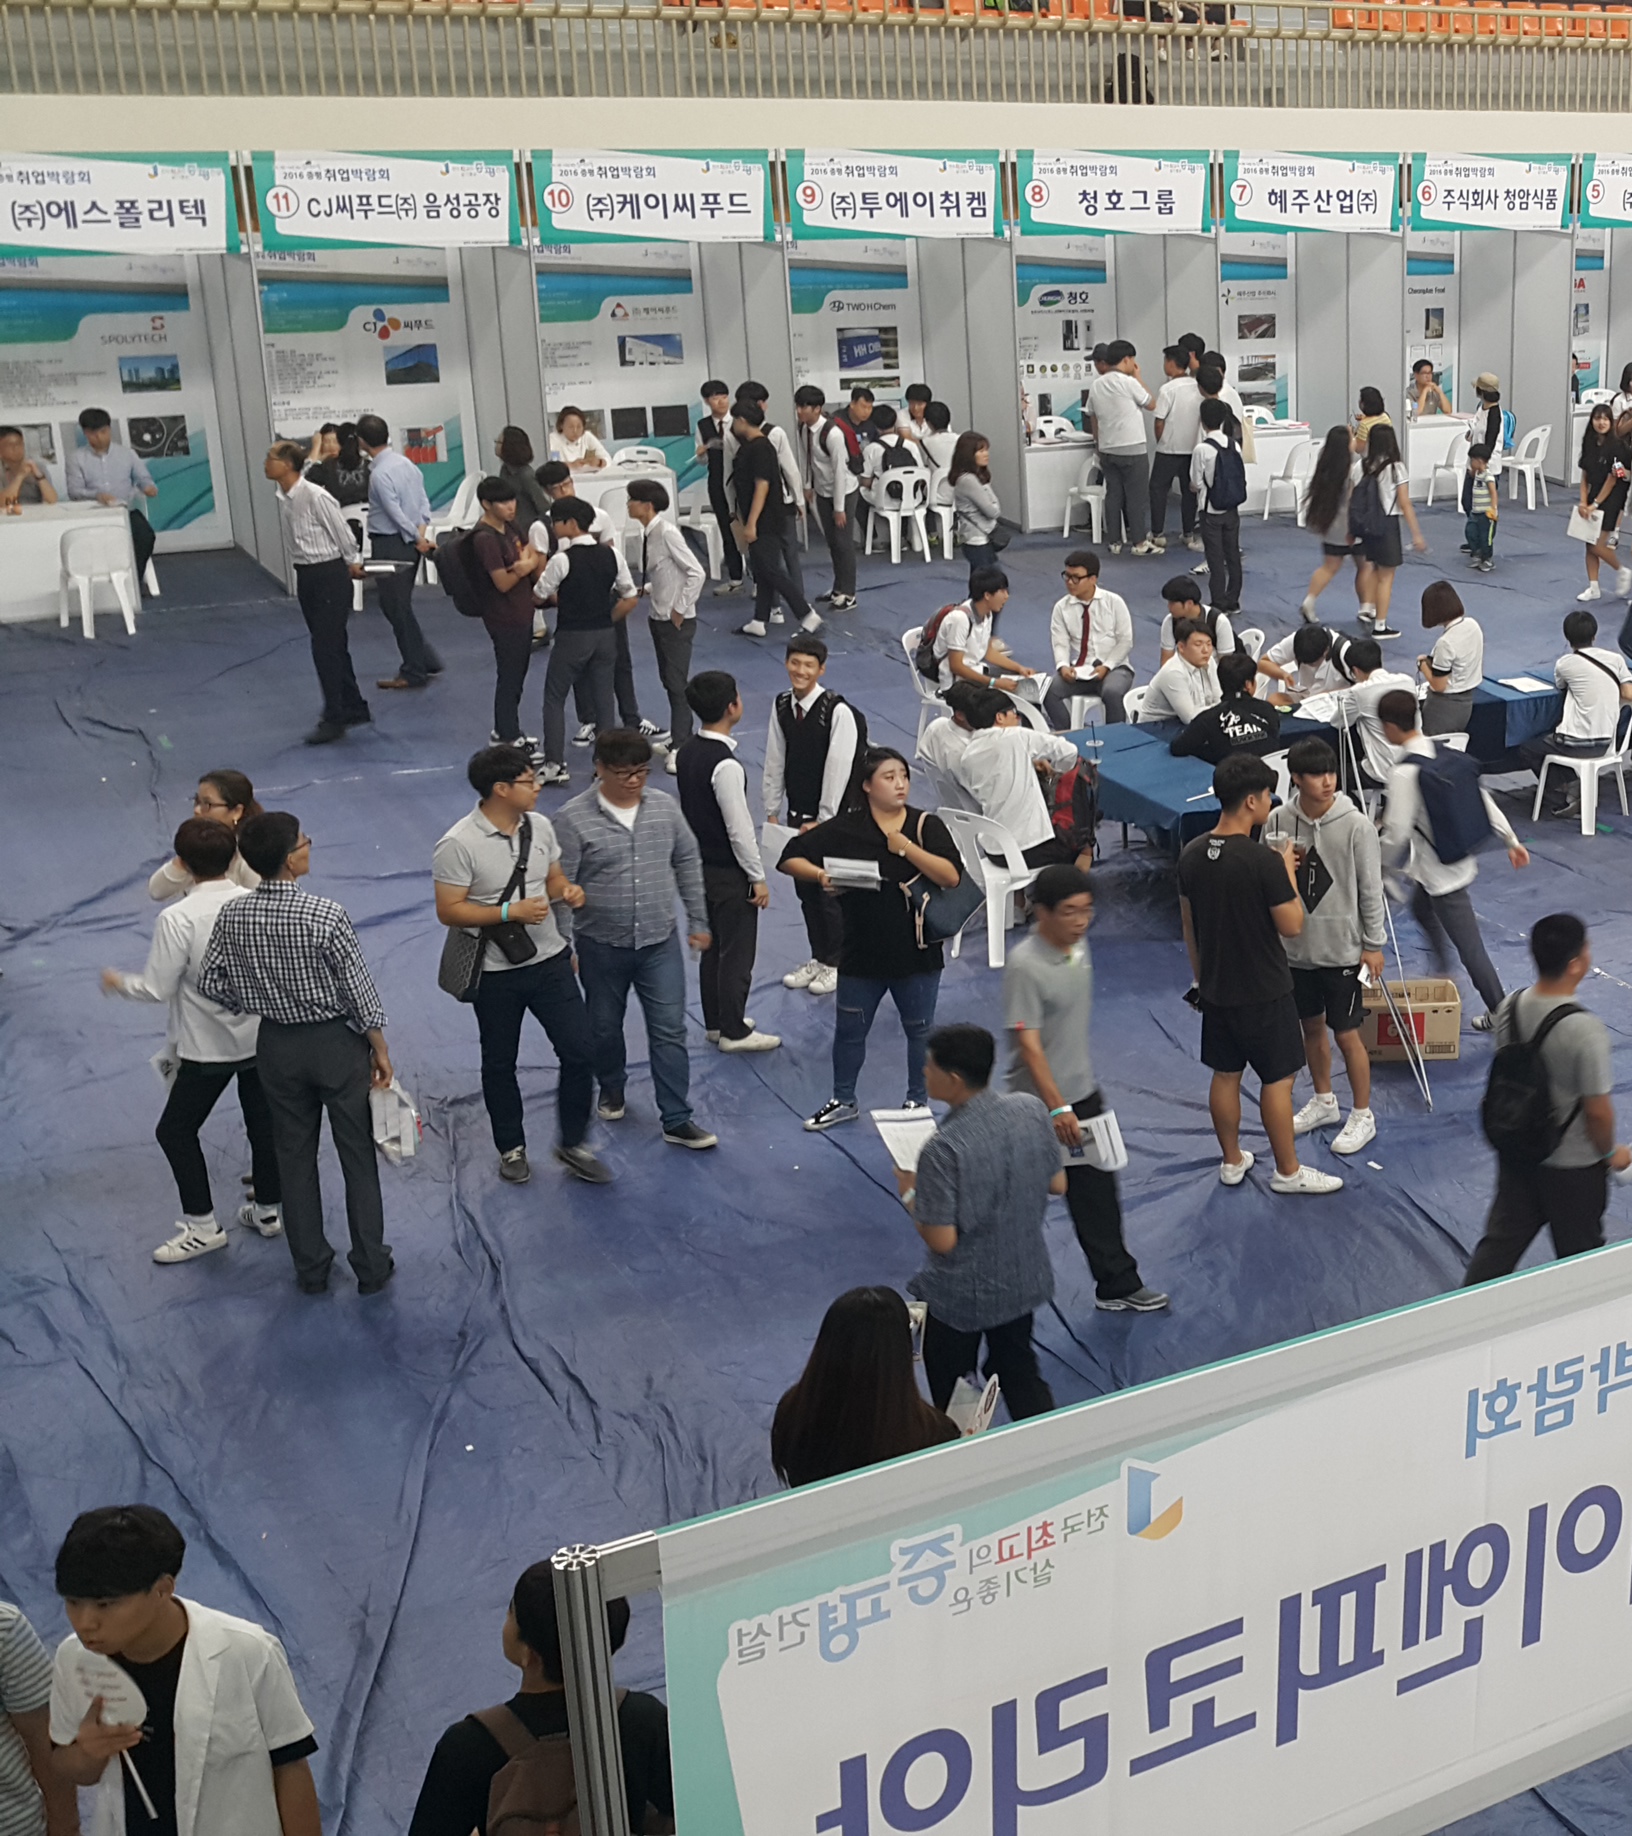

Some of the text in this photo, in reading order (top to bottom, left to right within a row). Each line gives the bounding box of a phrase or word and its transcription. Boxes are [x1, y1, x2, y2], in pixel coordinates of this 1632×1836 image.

[17, 170, 91, 185] 취업박람회
[283, 171, 303, 180] 2016
[325, 168, 390, 182] 취업박람회
[597, 166, 656, 179] 취업박람회
[811, 168, 827, 176] 2016
[844, 165, 898, 177] 취업박람회
[1069, 164, 1118, 177] 취업박람회
[1271, 165, 1315, 177] 취업박람회
[1455, 167, 1495, 178] 취업박람회
[548, 189, 570, 208] 10
[802, 186, 816, 204] 9
[1031, 185, 1044, 202] 8
[1236, 185, 1247, 201] 7
[1422, 185, 1432, 201] 6
[1591, 184, 1600, 198] 5
[272, 192, 290, 212] 11
[307, 193, 501, 220] CJ씨푸드(주) 음성공장
[587, 193, 751, 221] (주)케이씨푸드
[831, 191, 987, 220] (주)투에이취켐
[1078, 190, 1175, 216] 청호그룹
[1442, 188, 1558, 211] 주식회사 청암식품
[11, 200, 207, 231] (주)에스폴리텍
[1067, 291, 1089, 305] 청호
[363, 319, 435, 333] CJ 씨푸드
[100, 334, 167, 346] SPOLYTECH
